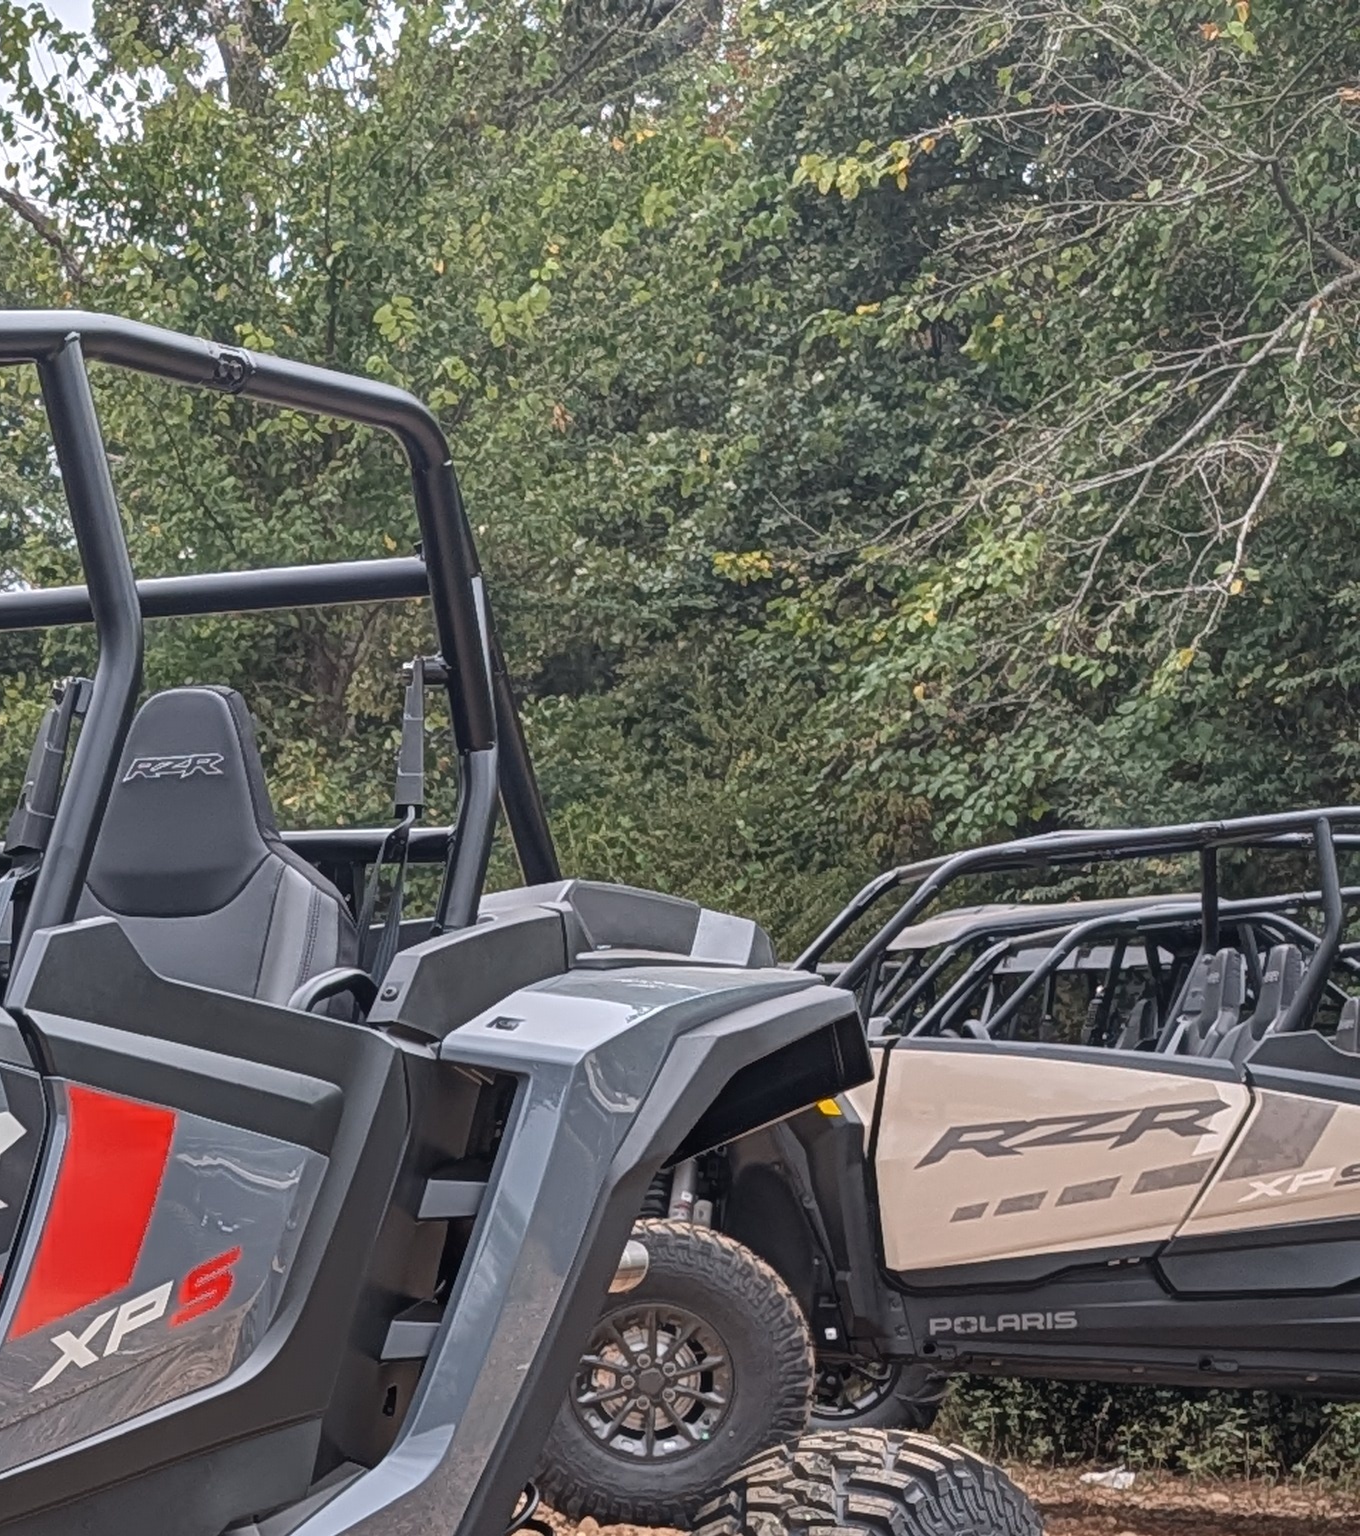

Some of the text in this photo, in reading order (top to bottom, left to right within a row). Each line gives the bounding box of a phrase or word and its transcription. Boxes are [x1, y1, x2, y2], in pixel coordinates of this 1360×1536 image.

[122, 752, 225, 783] RZR
[913, 1099, 1232, 1170] RZR
[928, 1310, 1079, 1336] POLARIS
